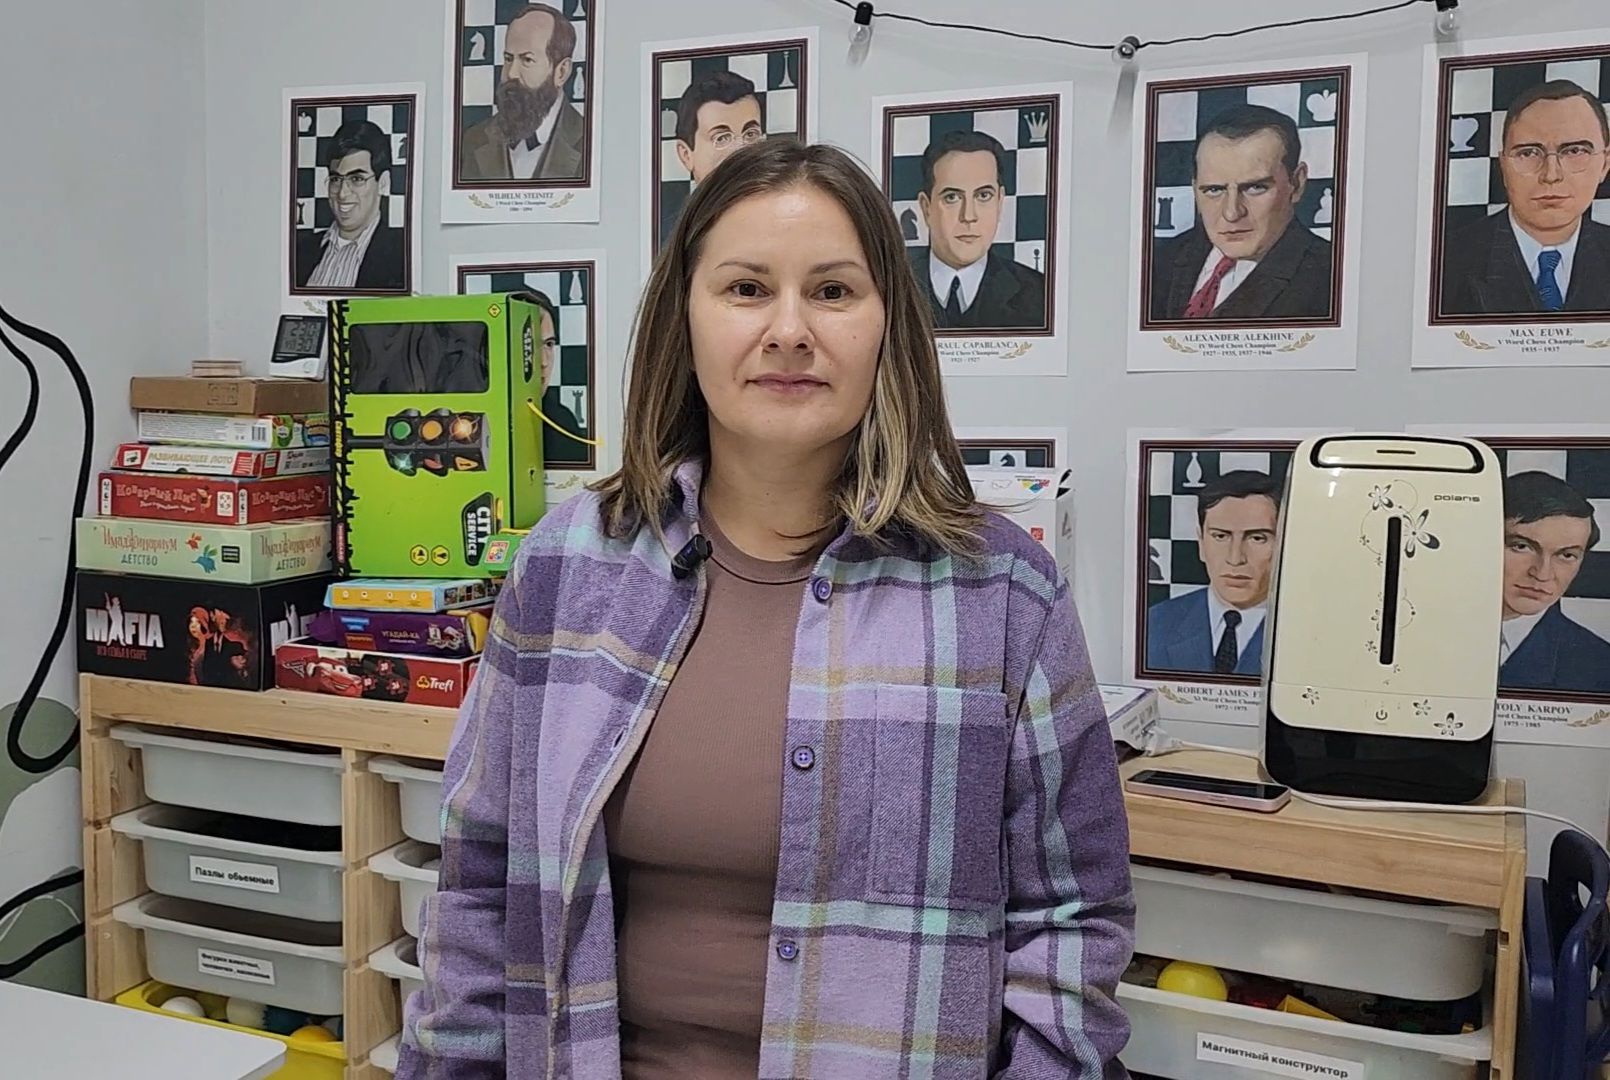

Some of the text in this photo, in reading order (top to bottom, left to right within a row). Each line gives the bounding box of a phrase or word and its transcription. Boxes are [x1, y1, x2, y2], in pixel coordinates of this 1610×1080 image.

[488, 192, 554, 200] WILHELM STEINITZ
[1183, 332, 1294, 342] ALEXANDER ALEKHINE
[1510, 327, 1573, 337] MAX EUWE
[938, 341, 1018, 349] RAUL CAPABLANCA
[1548, 338, 1585, 346] Champion
[149, 452, 233, 464] РАЗВИВАЮЩЕЕ ЛОТО
[116, 484, 172, 501] Коварный
[1434, 494, 1480, 502] polaris
[477, 506, 491, 544] CITY
[100, 525, 178, 553] Имаджинариум
[467, 512, 477, 556] SERVICE
[121, 553, 158, 566] ДЕТСТВО
[276, 556, 306, 571] ДЕТСТВО
[85, 604, 165, 648] MAFIA
[430, 677, 454, 693] Trefl
[1177, 686, 1214, 695] ROBERT
[1218, 689, 1249, 698] JAMES
[1527, 704, 1573, 714] KARPOV
[1532, 714, 1568, 722] Champion
[195, 866, 225, 879] Пазлы
[1202, 1040, 1349, 1079] Магнитный конструктор
